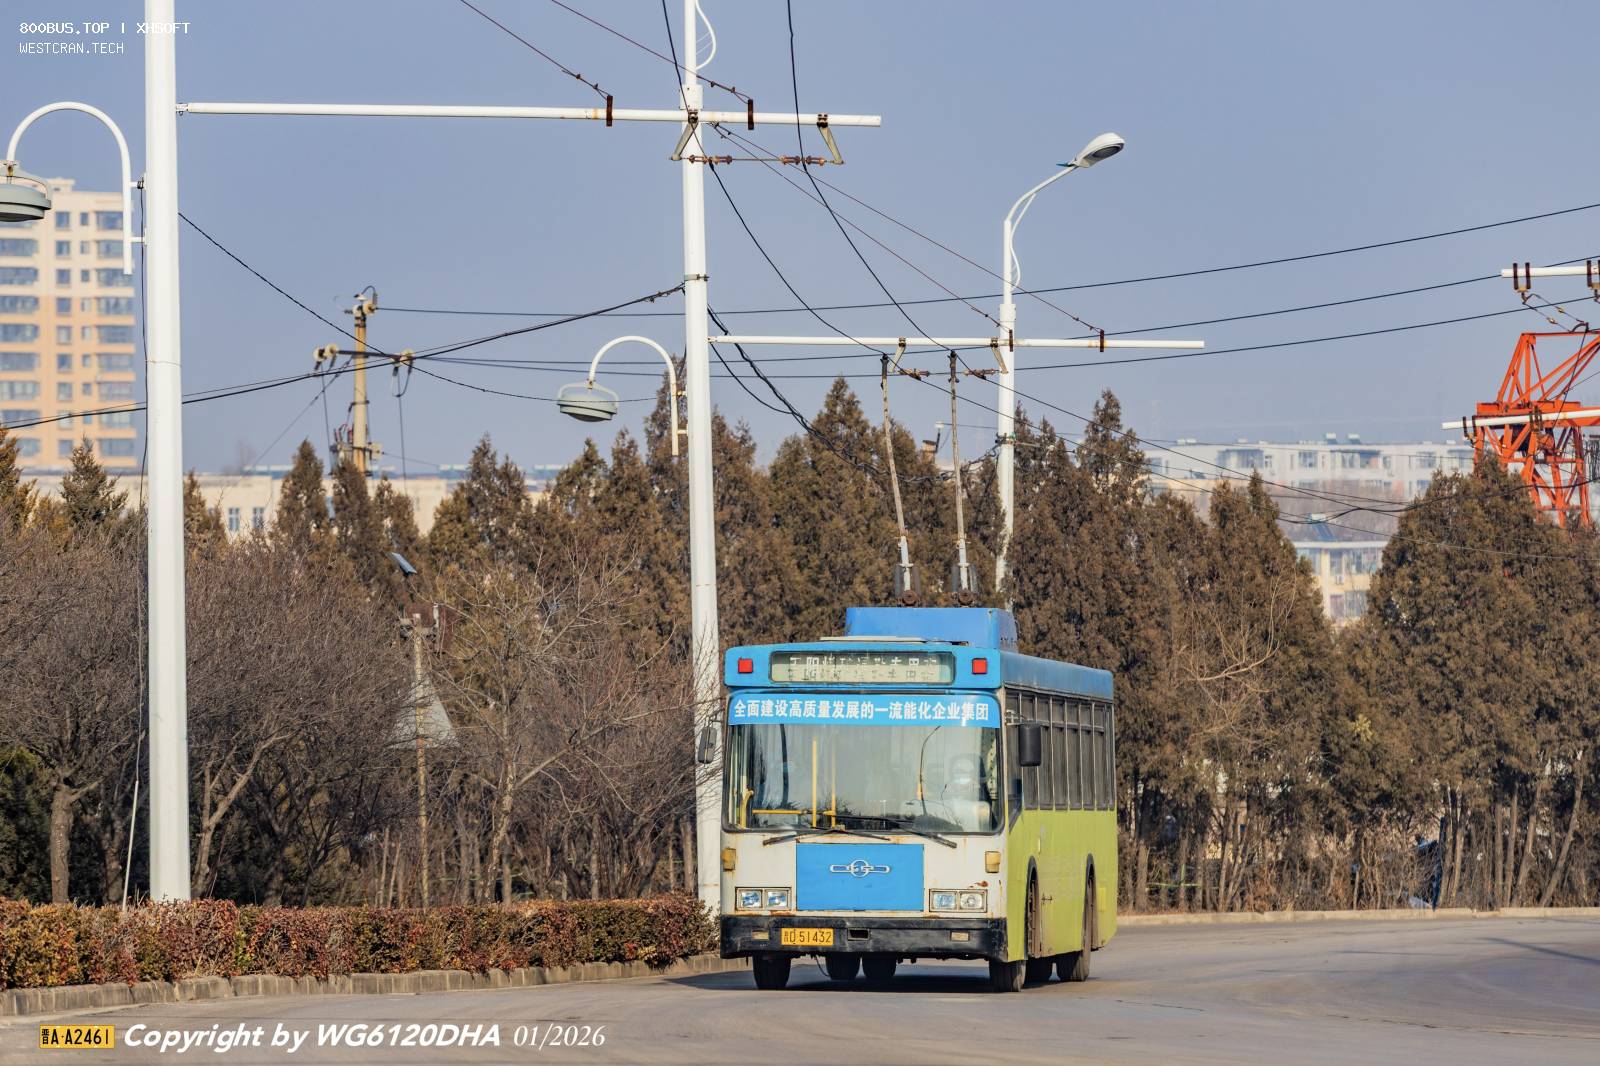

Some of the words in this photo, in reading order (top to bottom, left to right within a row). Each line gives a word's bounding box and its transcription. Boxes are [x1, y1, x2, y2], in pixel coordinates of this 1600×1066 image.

[734, 699, 989, 721] 全面建设高质量发展的一流能化企业集团
